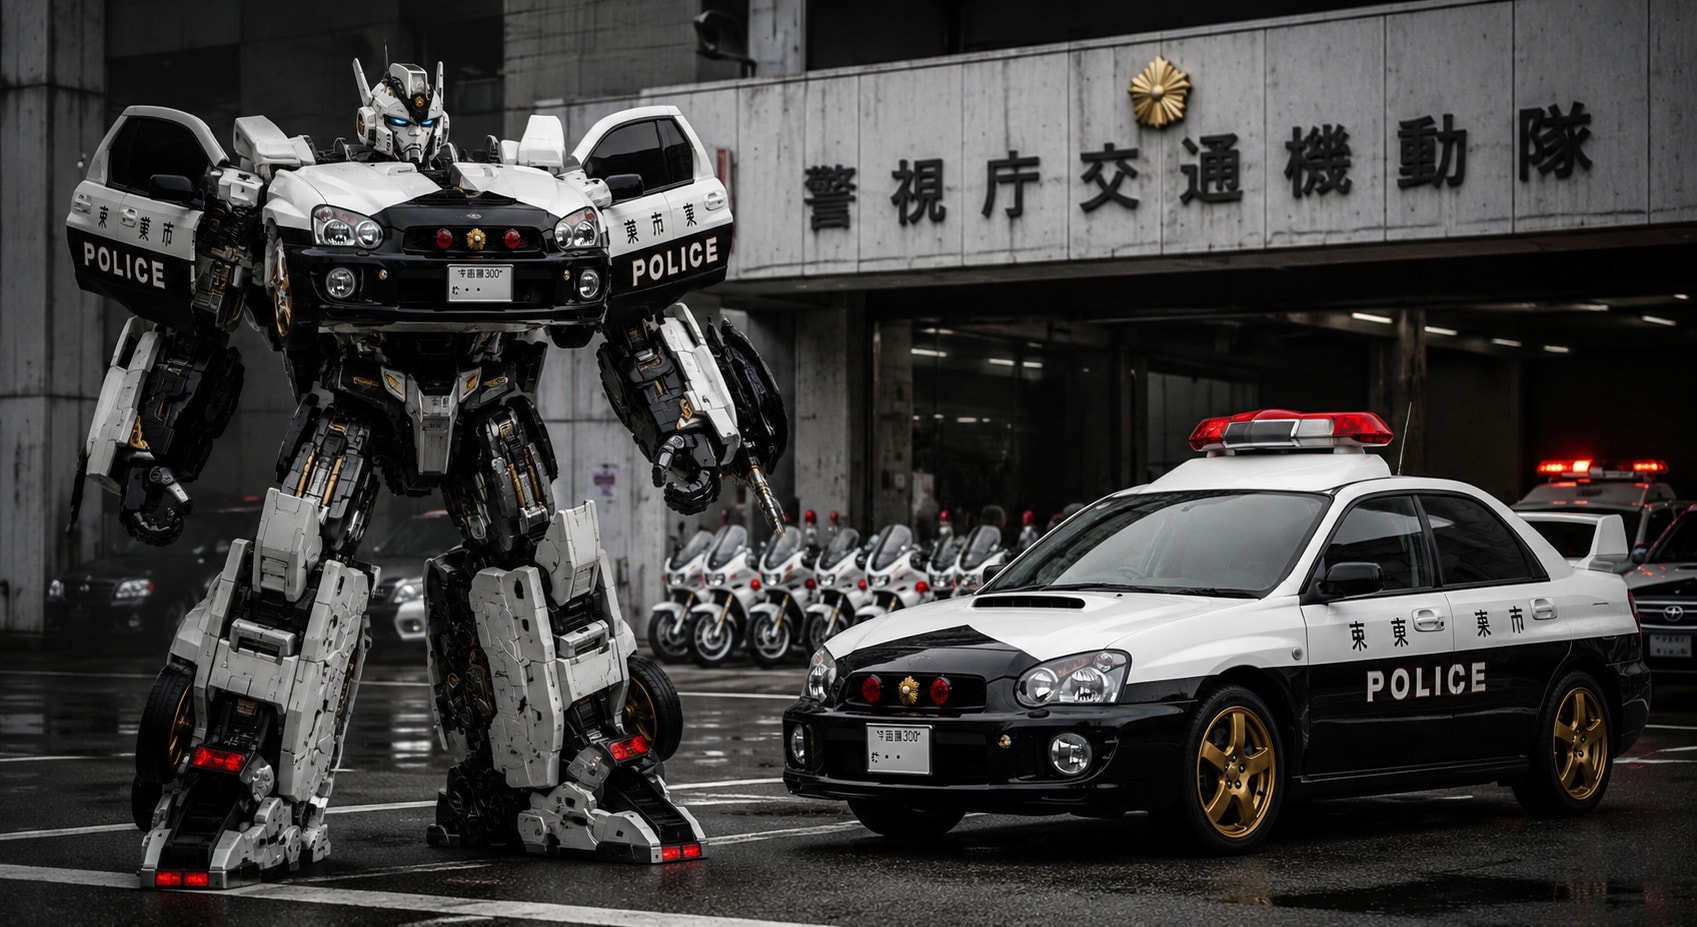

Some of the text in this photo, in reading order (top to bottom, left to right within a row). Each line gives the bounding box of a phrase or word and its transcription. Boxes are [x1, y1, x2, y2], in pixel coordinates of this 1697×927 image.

[803, 100, 1594, 232] 警視庁交通機動隊
[83, 241, 166, 289] POLICE
[631, 236, 719, 288] POLICE
[1366, 662, 1487, 702] POLICE
